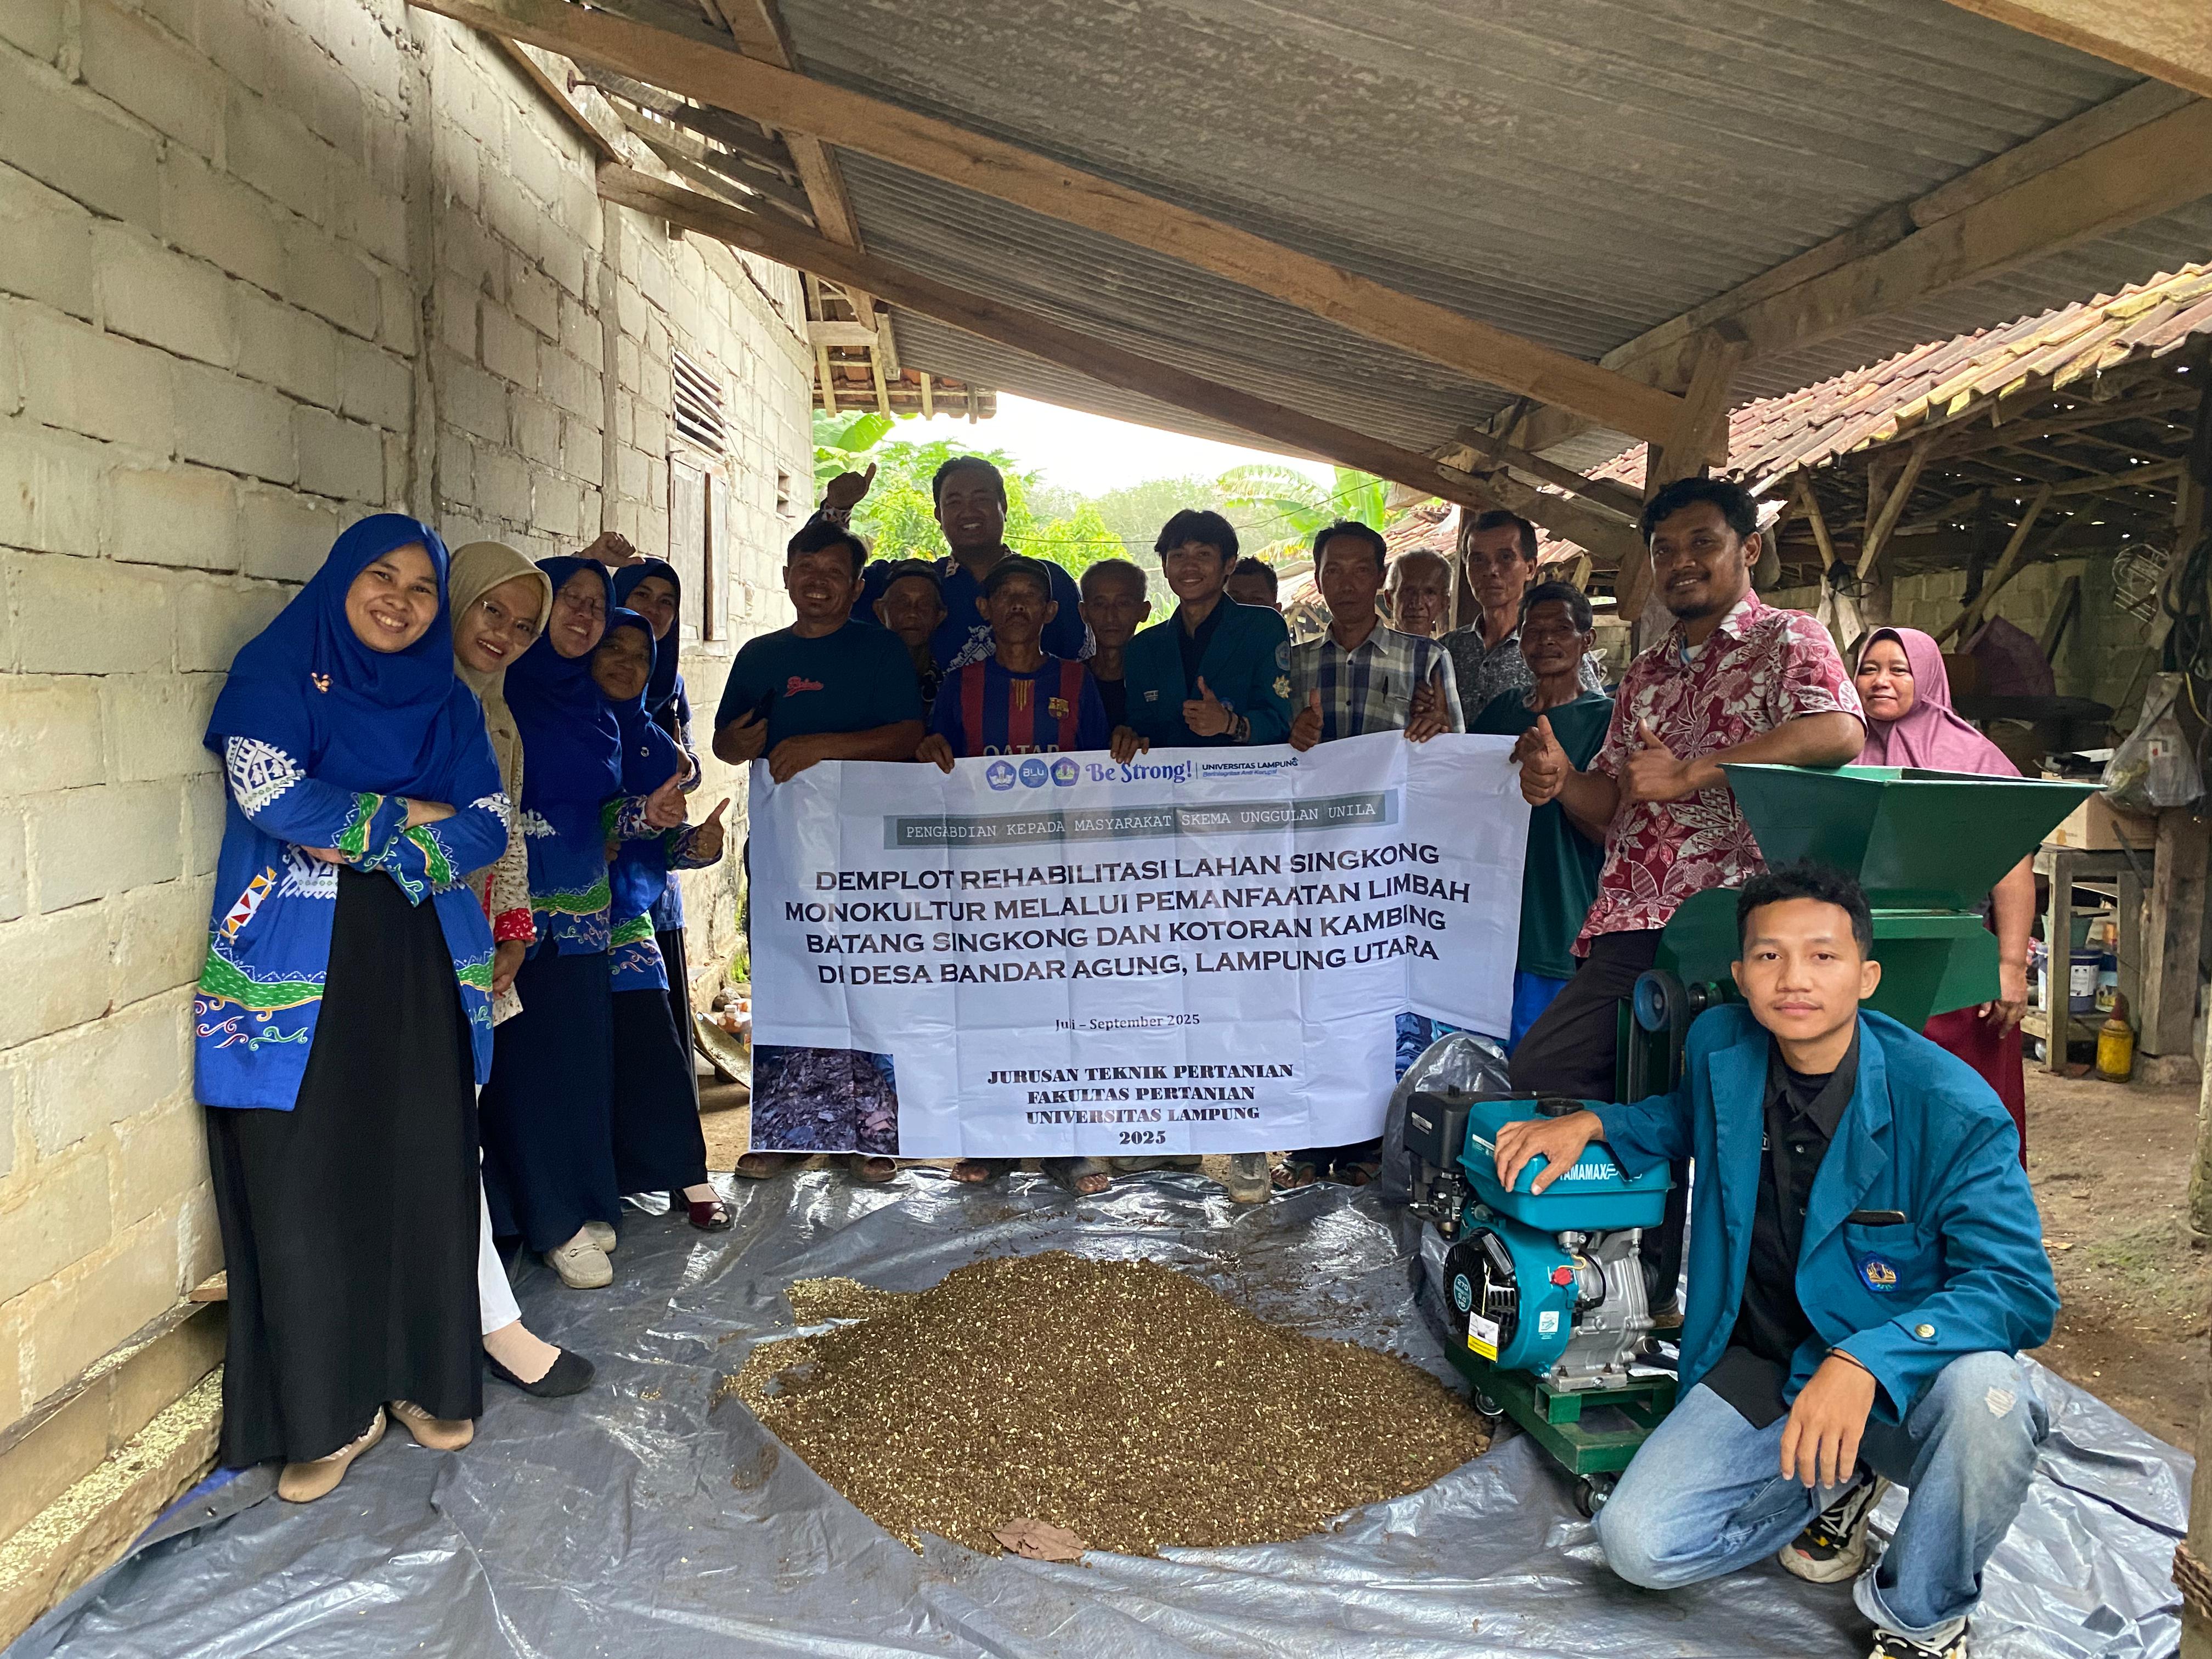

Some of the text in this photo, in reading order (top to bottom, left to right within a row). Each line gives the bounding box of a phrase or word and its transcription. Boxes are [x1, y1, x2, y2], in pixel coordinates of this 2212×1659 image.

[1023, 768, 1044, 777] BLU
[1086, 760, 1192, 783] Be Strong!
[1257, 760, 1299, 769] LAMPUNG
[906, 803, 1376, 839] PENGABDIAN KEPADA MASYARAKAT SKEMA UNGGULAN UNILA
[816, 843, 1440, 891] DEMPLOT REHABILITASI LAHAN SINGKONG
[786, 873, 1470, 923] MONOKULTUR MELALUI PEMANFAATAN LIMBAH
[806, 904, 1447, 954] BATANG SINGKONG DAN KOTORAN KAMBING
[819, 935, 1440, 985] DI DESA BANDAR AGUNG, LAMPUNG UTARA
[1054, 1018, 1075, 1032] Juli
[1089, 1015, 1164, 1031] September
[1167, 1013, 1201, 1027] 2025
[987, 1063, 1294, 1085] JURUSAN TEKNIK PERTANIAN
[1027, 1086, 1256, 1104] FAKULTAS PERTANIAN
[1025, 1106, 1260, 1125] UNIVERSITAS LAMPUNG
[1119, 1130, 1167, 1146] 2025
[1457, 1278, 1469, 1291] 270
